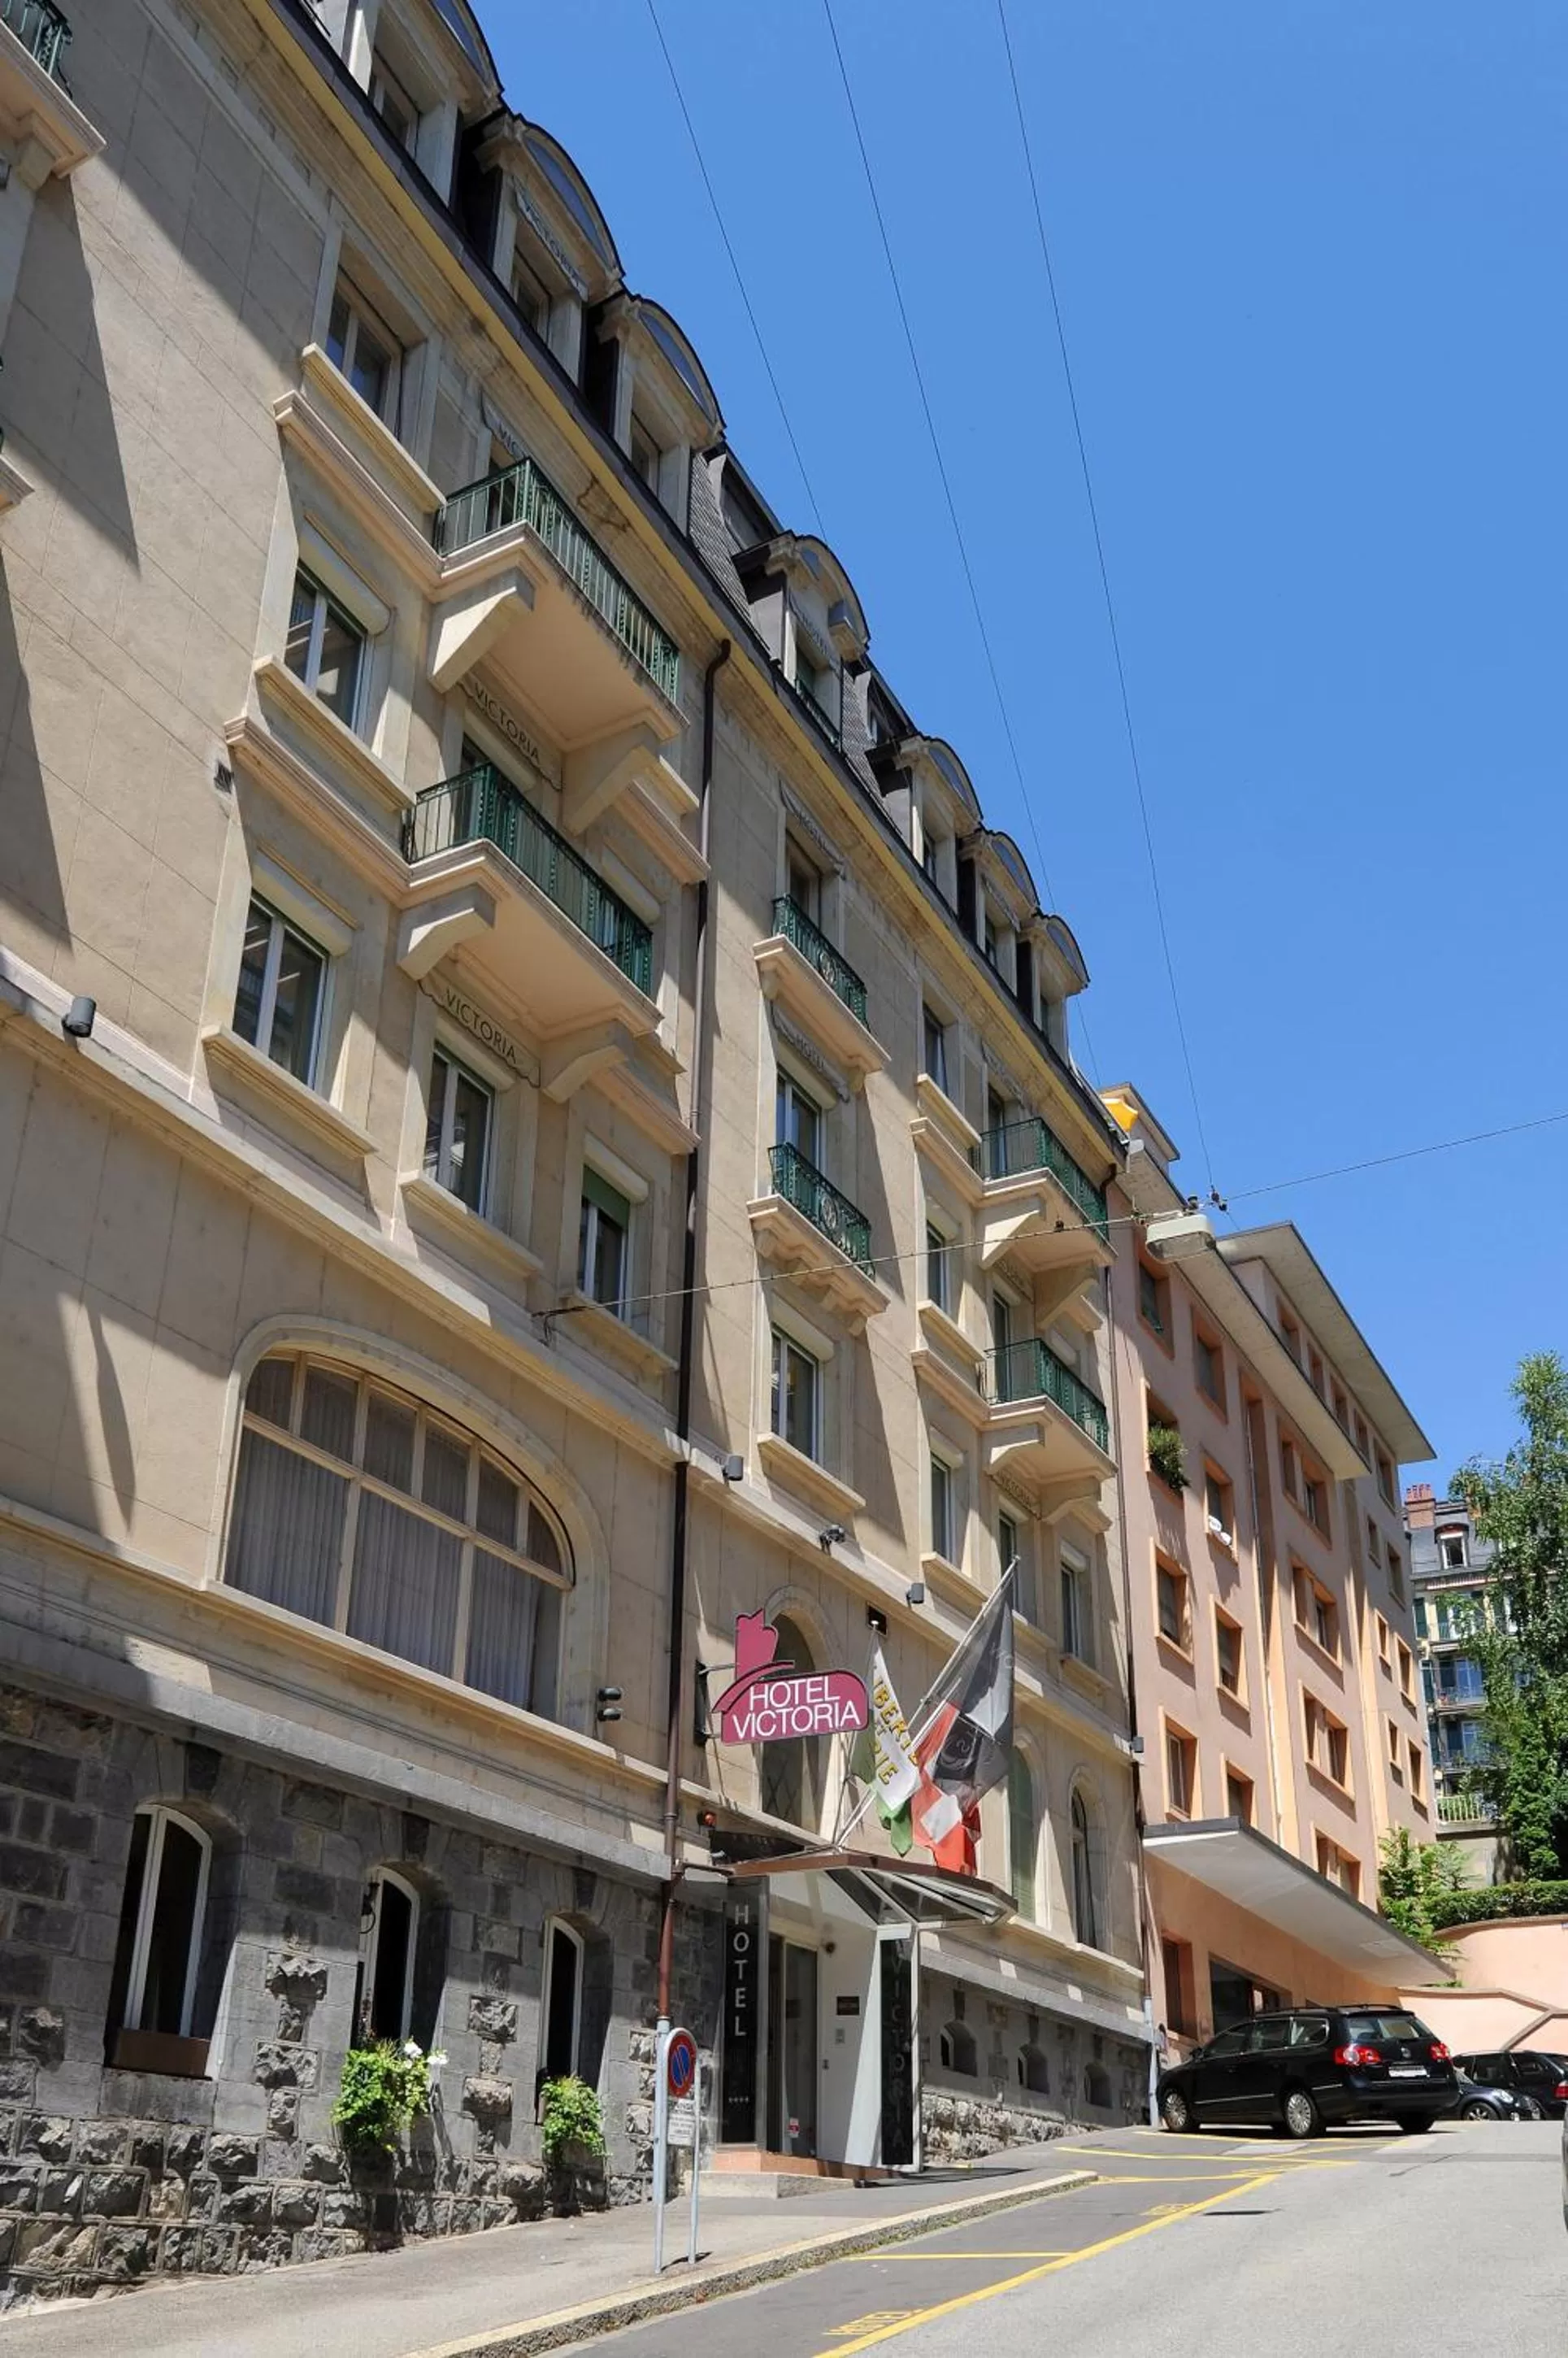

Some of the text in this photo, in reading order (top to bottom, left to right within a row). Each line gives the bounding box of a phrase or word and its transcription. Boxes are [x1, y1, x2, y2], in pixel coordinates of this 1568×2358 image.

[475, 682, 540, 764] VICTORIA
[446, 987, 516, 1064] VICTORIA
[733, 1700, 861, 1739] VICTORIA
[749, 1675, 840, 1711] HOTEL
[733, 1904, 749, 2036] HOTEL
